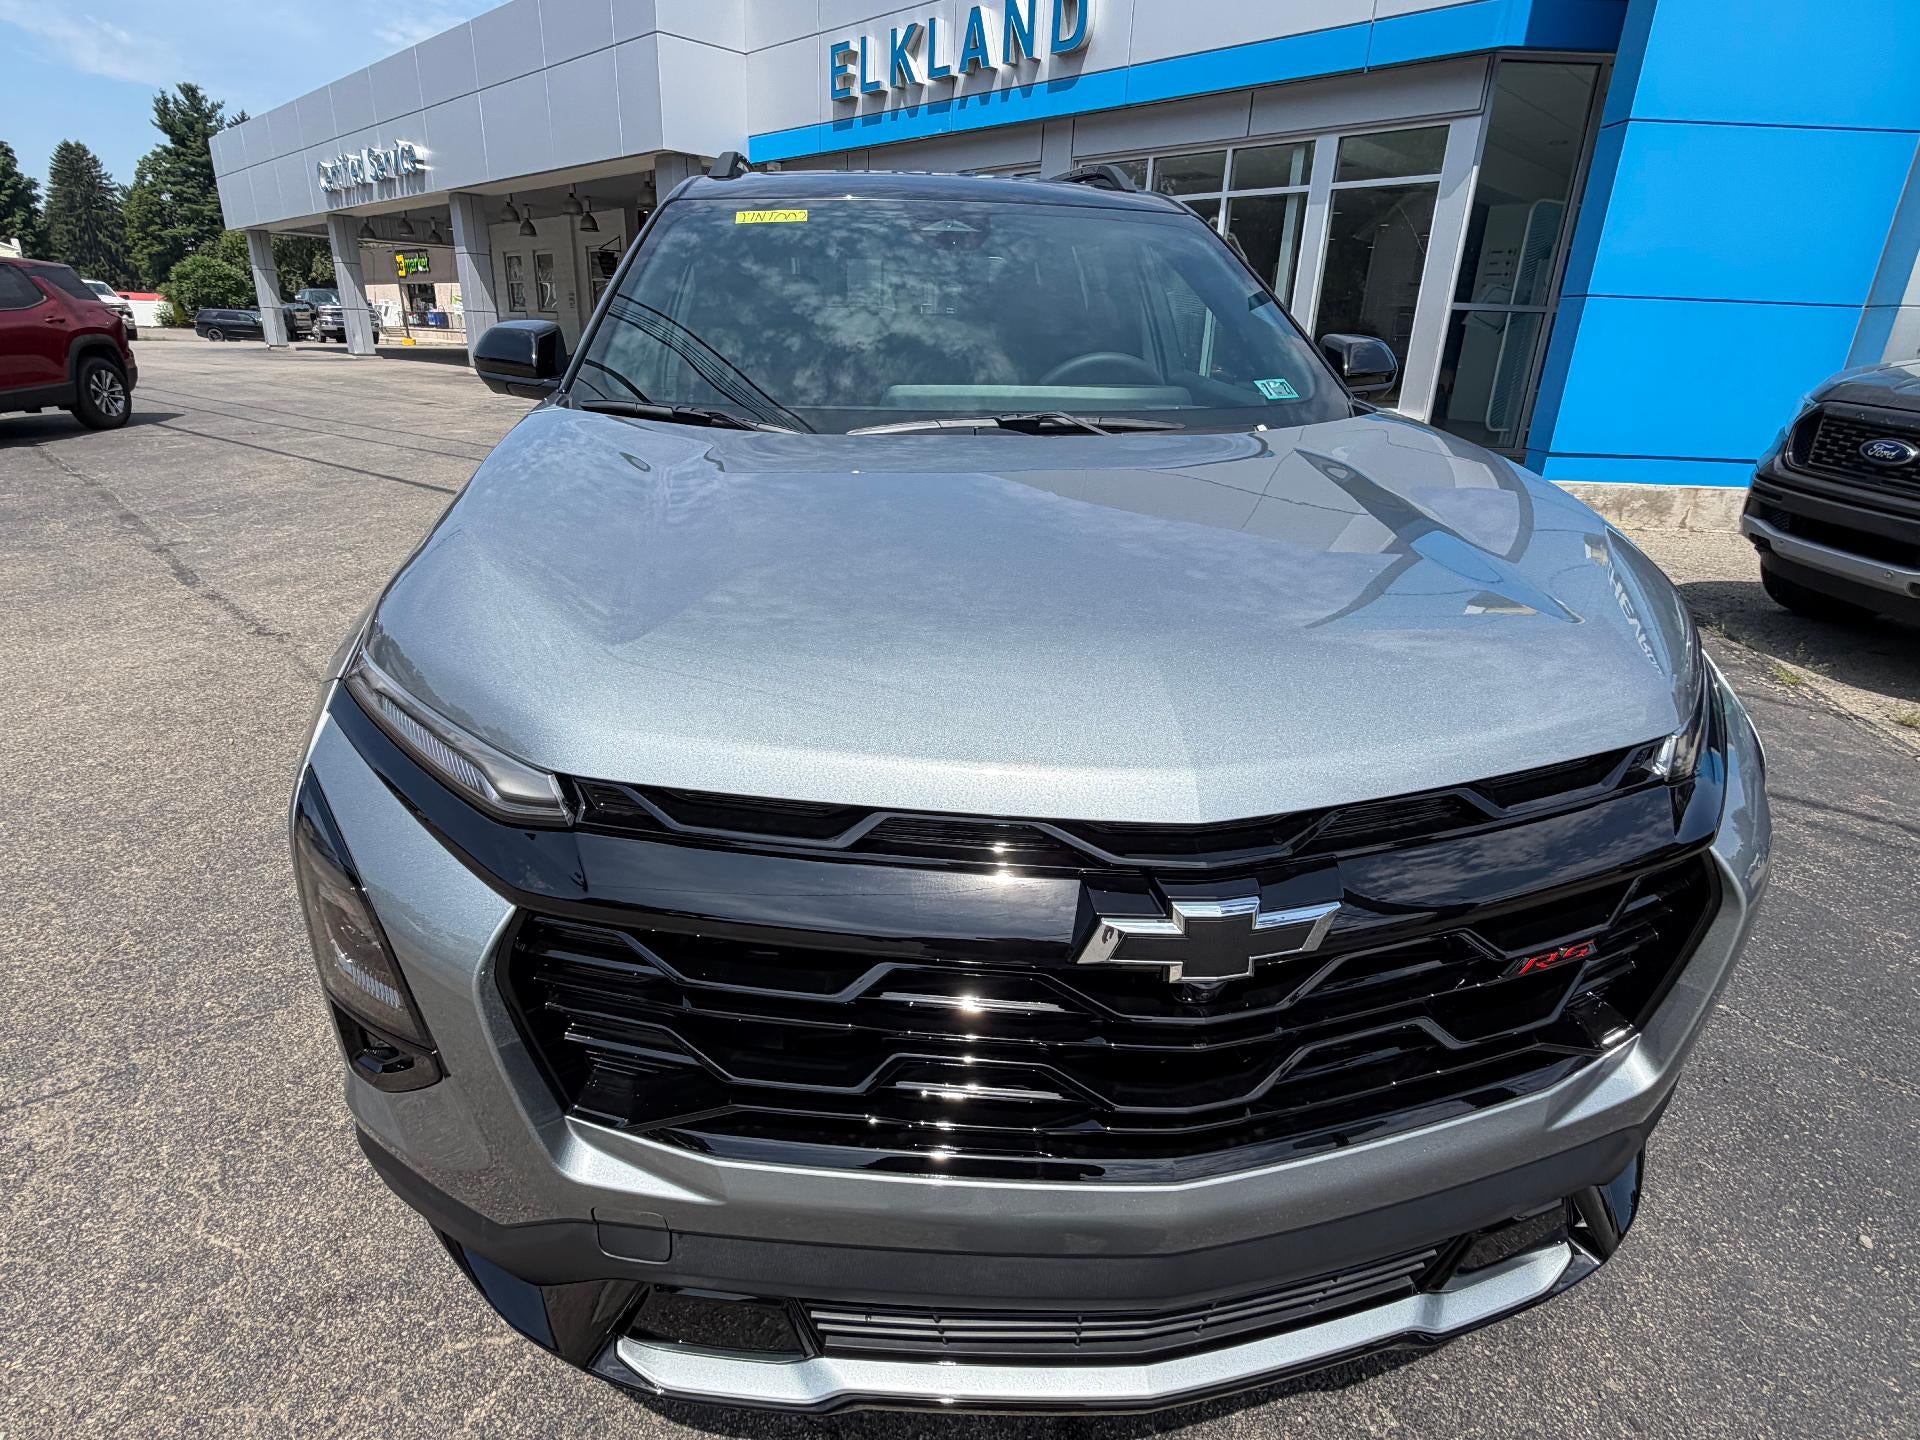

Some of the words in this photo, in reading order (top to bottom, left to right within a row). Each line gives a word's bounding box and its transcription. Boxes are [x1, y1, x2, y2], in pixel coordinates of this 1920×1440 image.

[830, 0, 1092, 101] ELKLAND
[1867, 442, 1900, 460] Ford
[1518, 940, 1596, 975] RS
